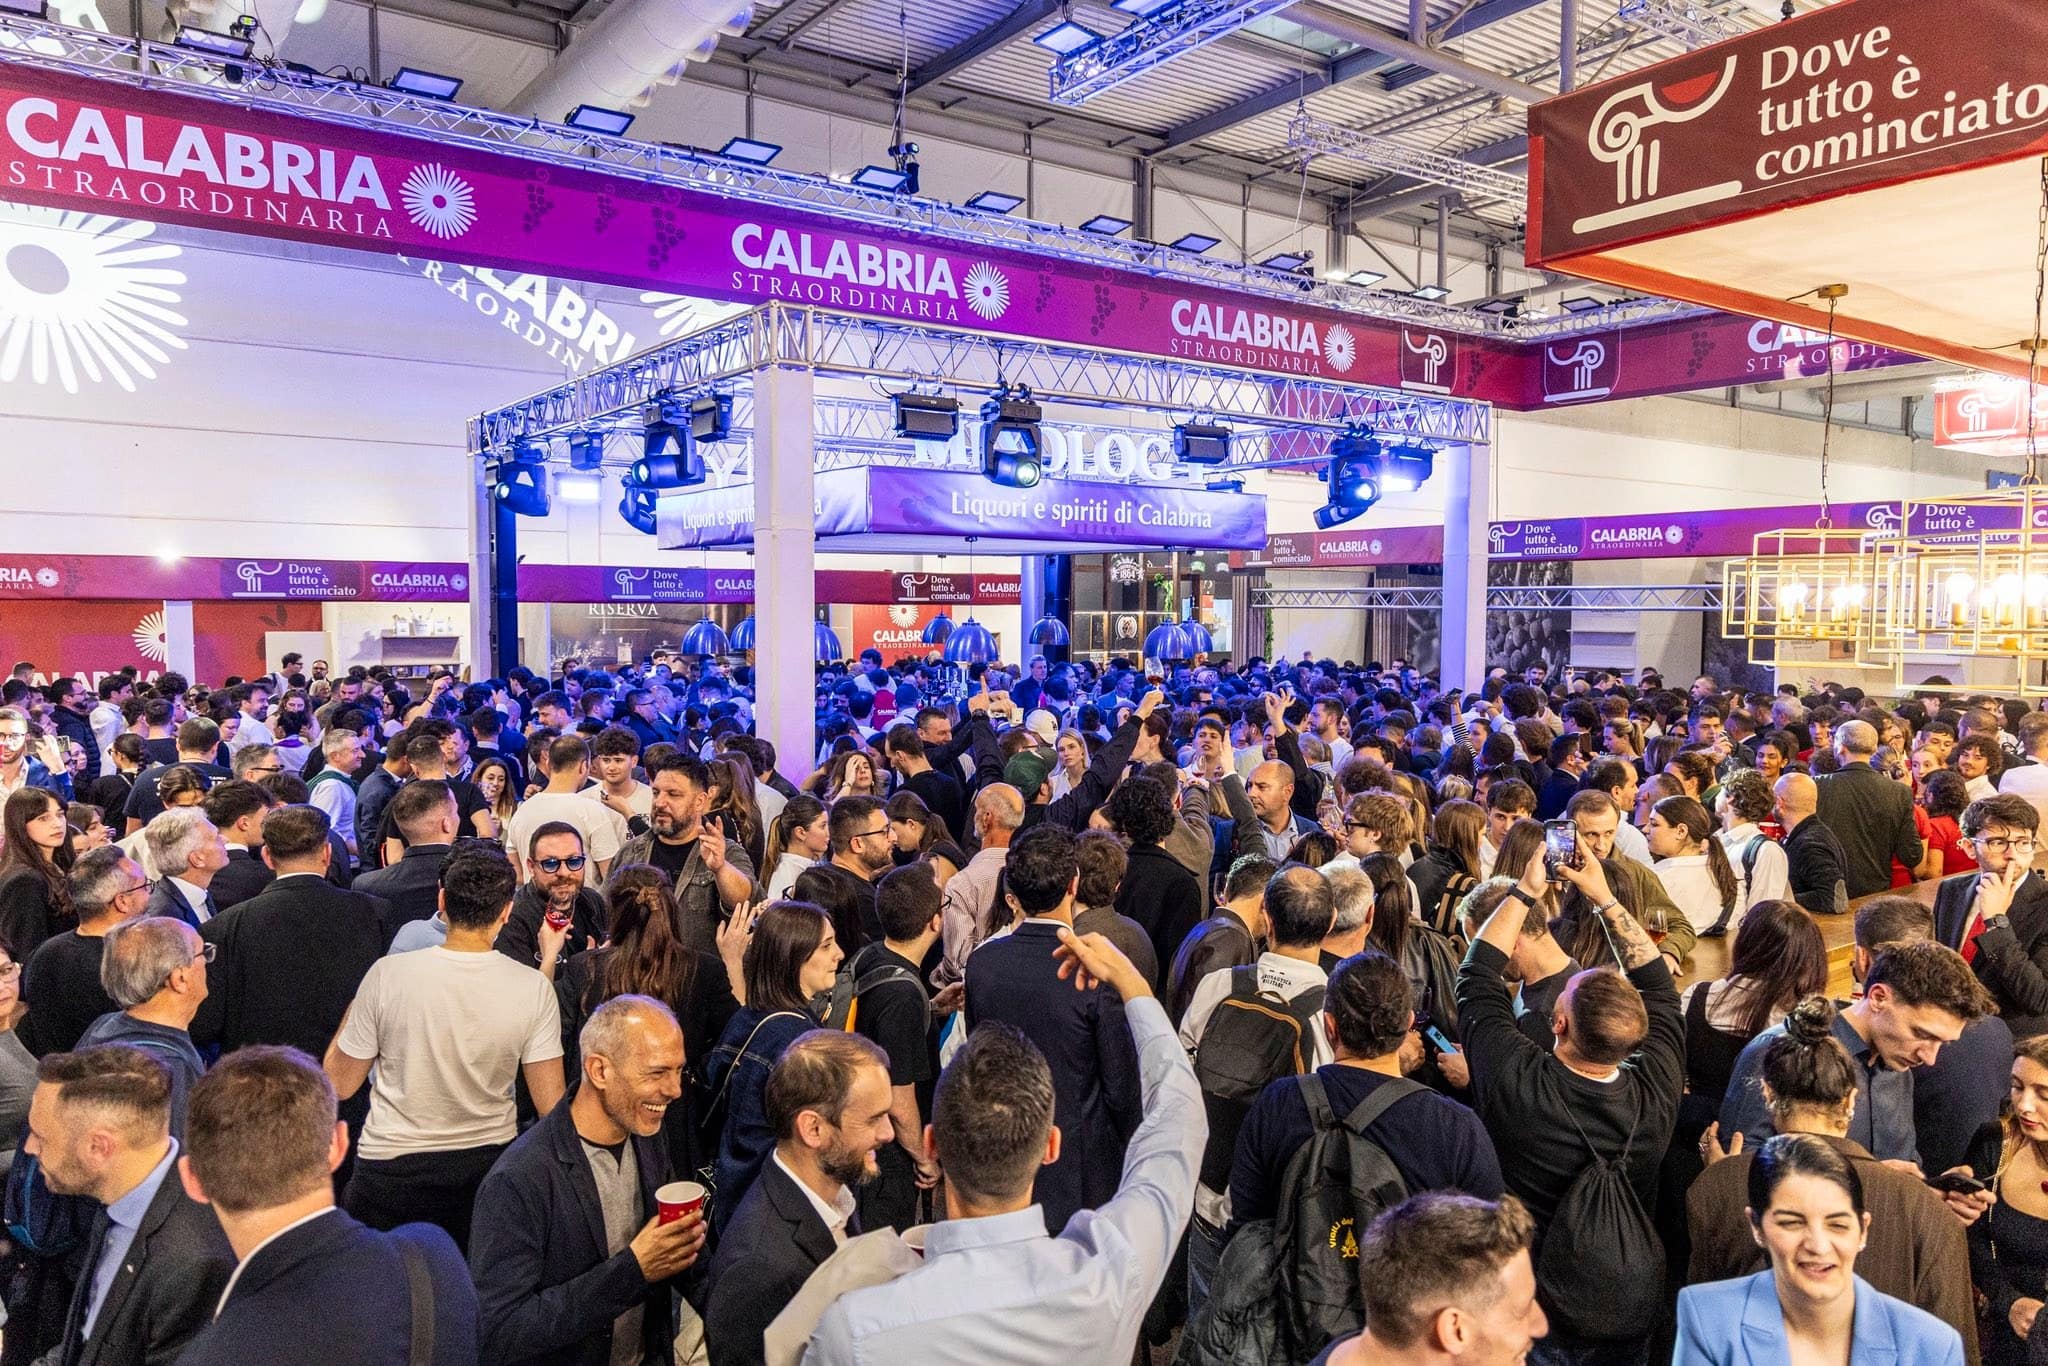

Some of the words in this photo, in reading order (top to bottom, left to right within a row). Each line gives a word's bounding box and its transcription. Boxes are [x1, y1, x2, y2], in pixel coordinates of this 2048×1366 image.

[1761, 26, 1891, 90] Dove
[1758, 78, 1874, 136] tutto
[1891, 54, 1921, 99] è
[1755, 82, 2048, 180] cominciato
[6, 97, 392, 211] CALABRIA
[8, 160, 393, 239] STRAORDINARIA
[731, 222, 959, 300] CALABRIA
[732, 271, 959, 321] STRAORDINARIA
[397, 253, 586, 373] RAORDIN
[1171, 299, 1321, 357] CALABRIA
[1170, 338, 1320, 374] STRAORDINARIA
[952, 491, 1027, 523] Liquori
[1033, 504, 1044, 518] e
[1052, 498, 1108, 528] spiriti
[1115, 500, 1132, 523] di
[1138, 502, 1213, 528] Calabria
[1925, 504, 1966, 517] Dove
[1925, 517, 1961, 530] tutto
[1965, 515, 1975, 528] è
[1525, 524, 1551, 534] Dove
[1591, 527, 1663, 543] CALABRIA
[1274, 537, 1292, 546] Dove
[1525, 535, 1548, 544] tutto
[1550, 533, 1557, 543] è
[1273, 546, 1290, 555] tutto
[1291, 545, 1296, 554] è
[1319, 541, 1369, 553] CALABRIA
[1524, 544, 1578, 556] cominciato
[1591, 541, 1664, 549] STRAORDINARIA
[1273, 554, 1311, 563] cominciato
[289, 563, 322, 574] Dove
[288, 575, 318, 585] tutto
[321, 574, 329, 585] è
[371, 573, 448, 587] CALABRIA
[653, 570, 678, 580] Dove
[931, 576, 950, 584] Dove
[653, 580, 676, 588] tutto
[678, 579, 684, 588] è
[715, 578, 754, 590] CALAB
[931, 584, 949, 592] tutto
[289, 586, 356, 596] cominciato
[653, 588, 704, 598] cominciato
[931, 592, 970, 600] cominciato
[588, 602, 659, 615] RISERVA
[873, 630, 924, 643] CALABR
